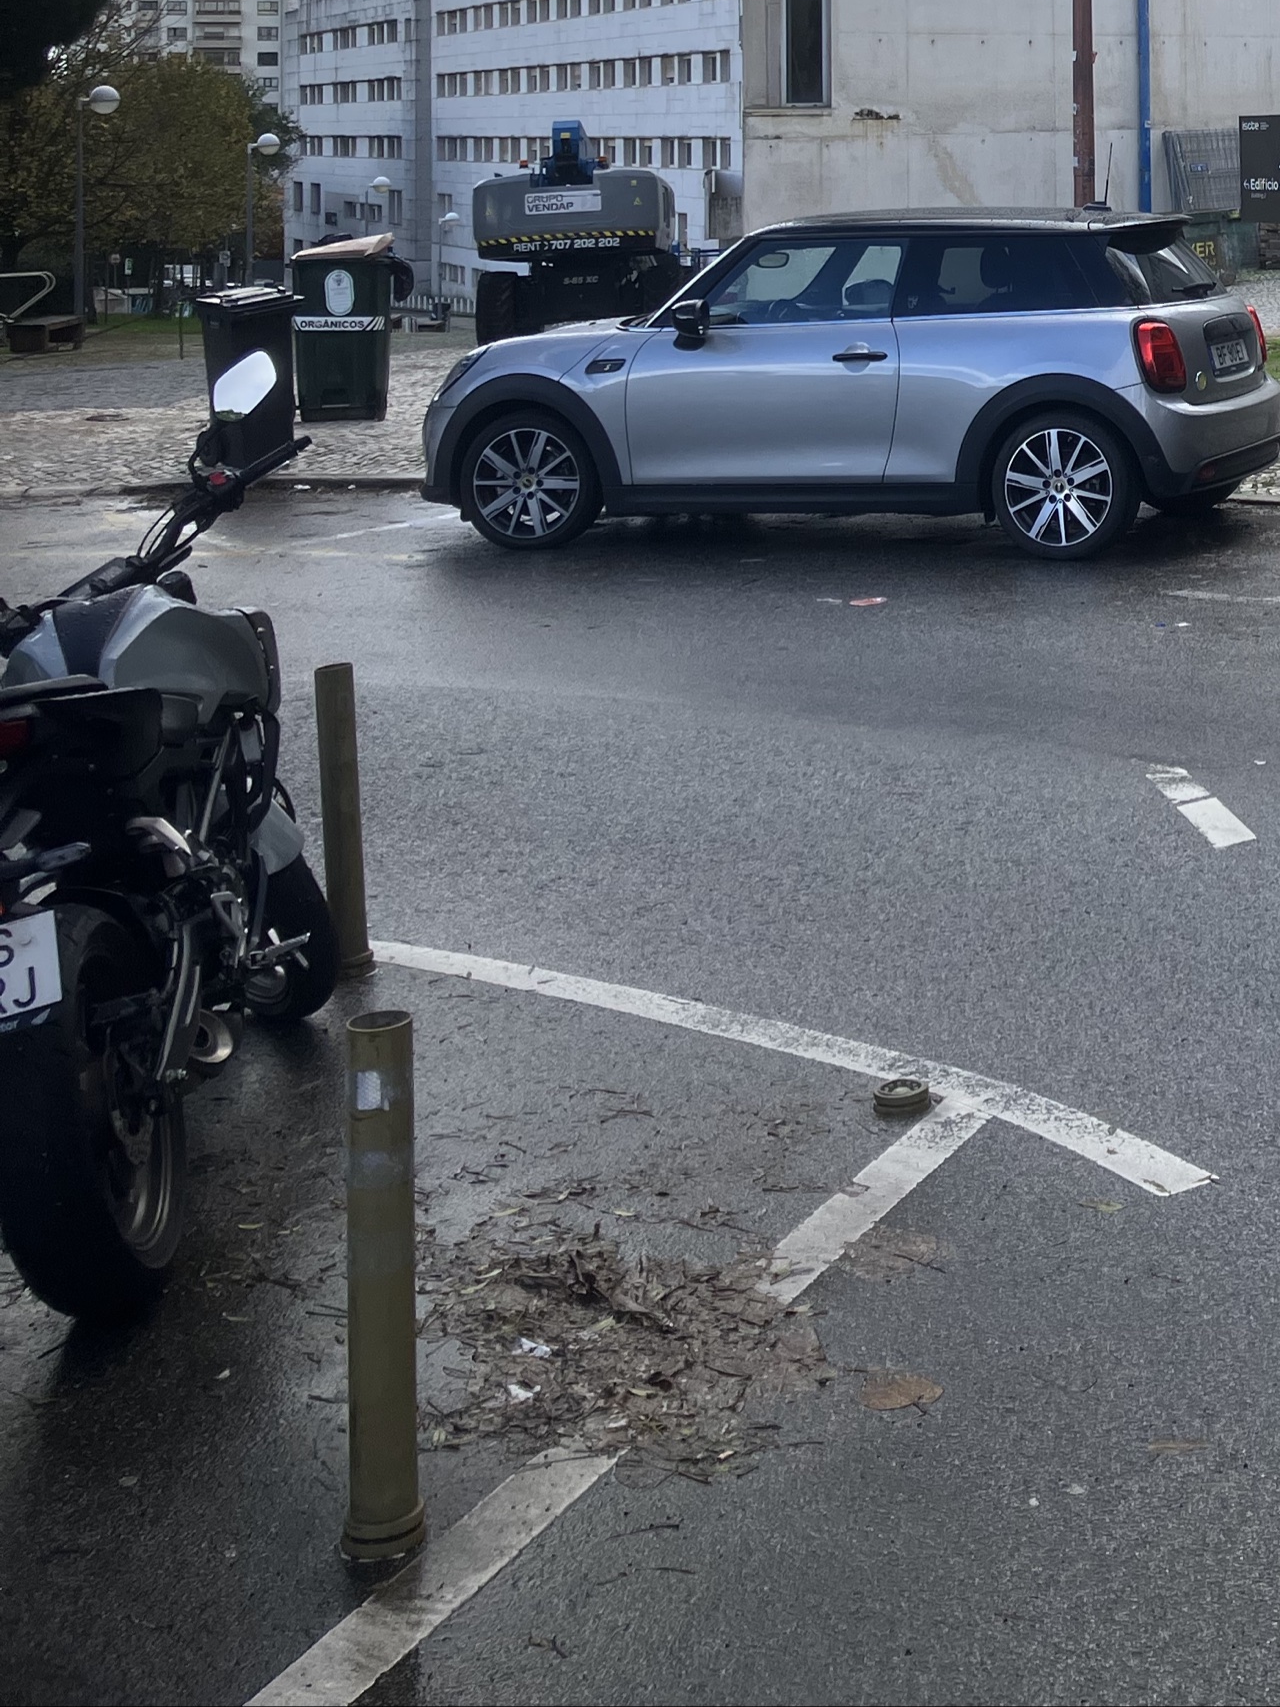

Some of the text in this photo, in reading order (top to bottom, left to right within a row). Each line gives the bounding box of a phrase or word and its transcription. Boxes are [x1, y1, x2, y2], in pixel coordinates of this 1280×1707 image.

[526, 195, 563, 204] GRUPO
[527, 202, 574, 213] VENDAP
[513, 237, 620, 252] RENT 707 202 202
[300, 319, 365, 329] ORGÂNICOS
